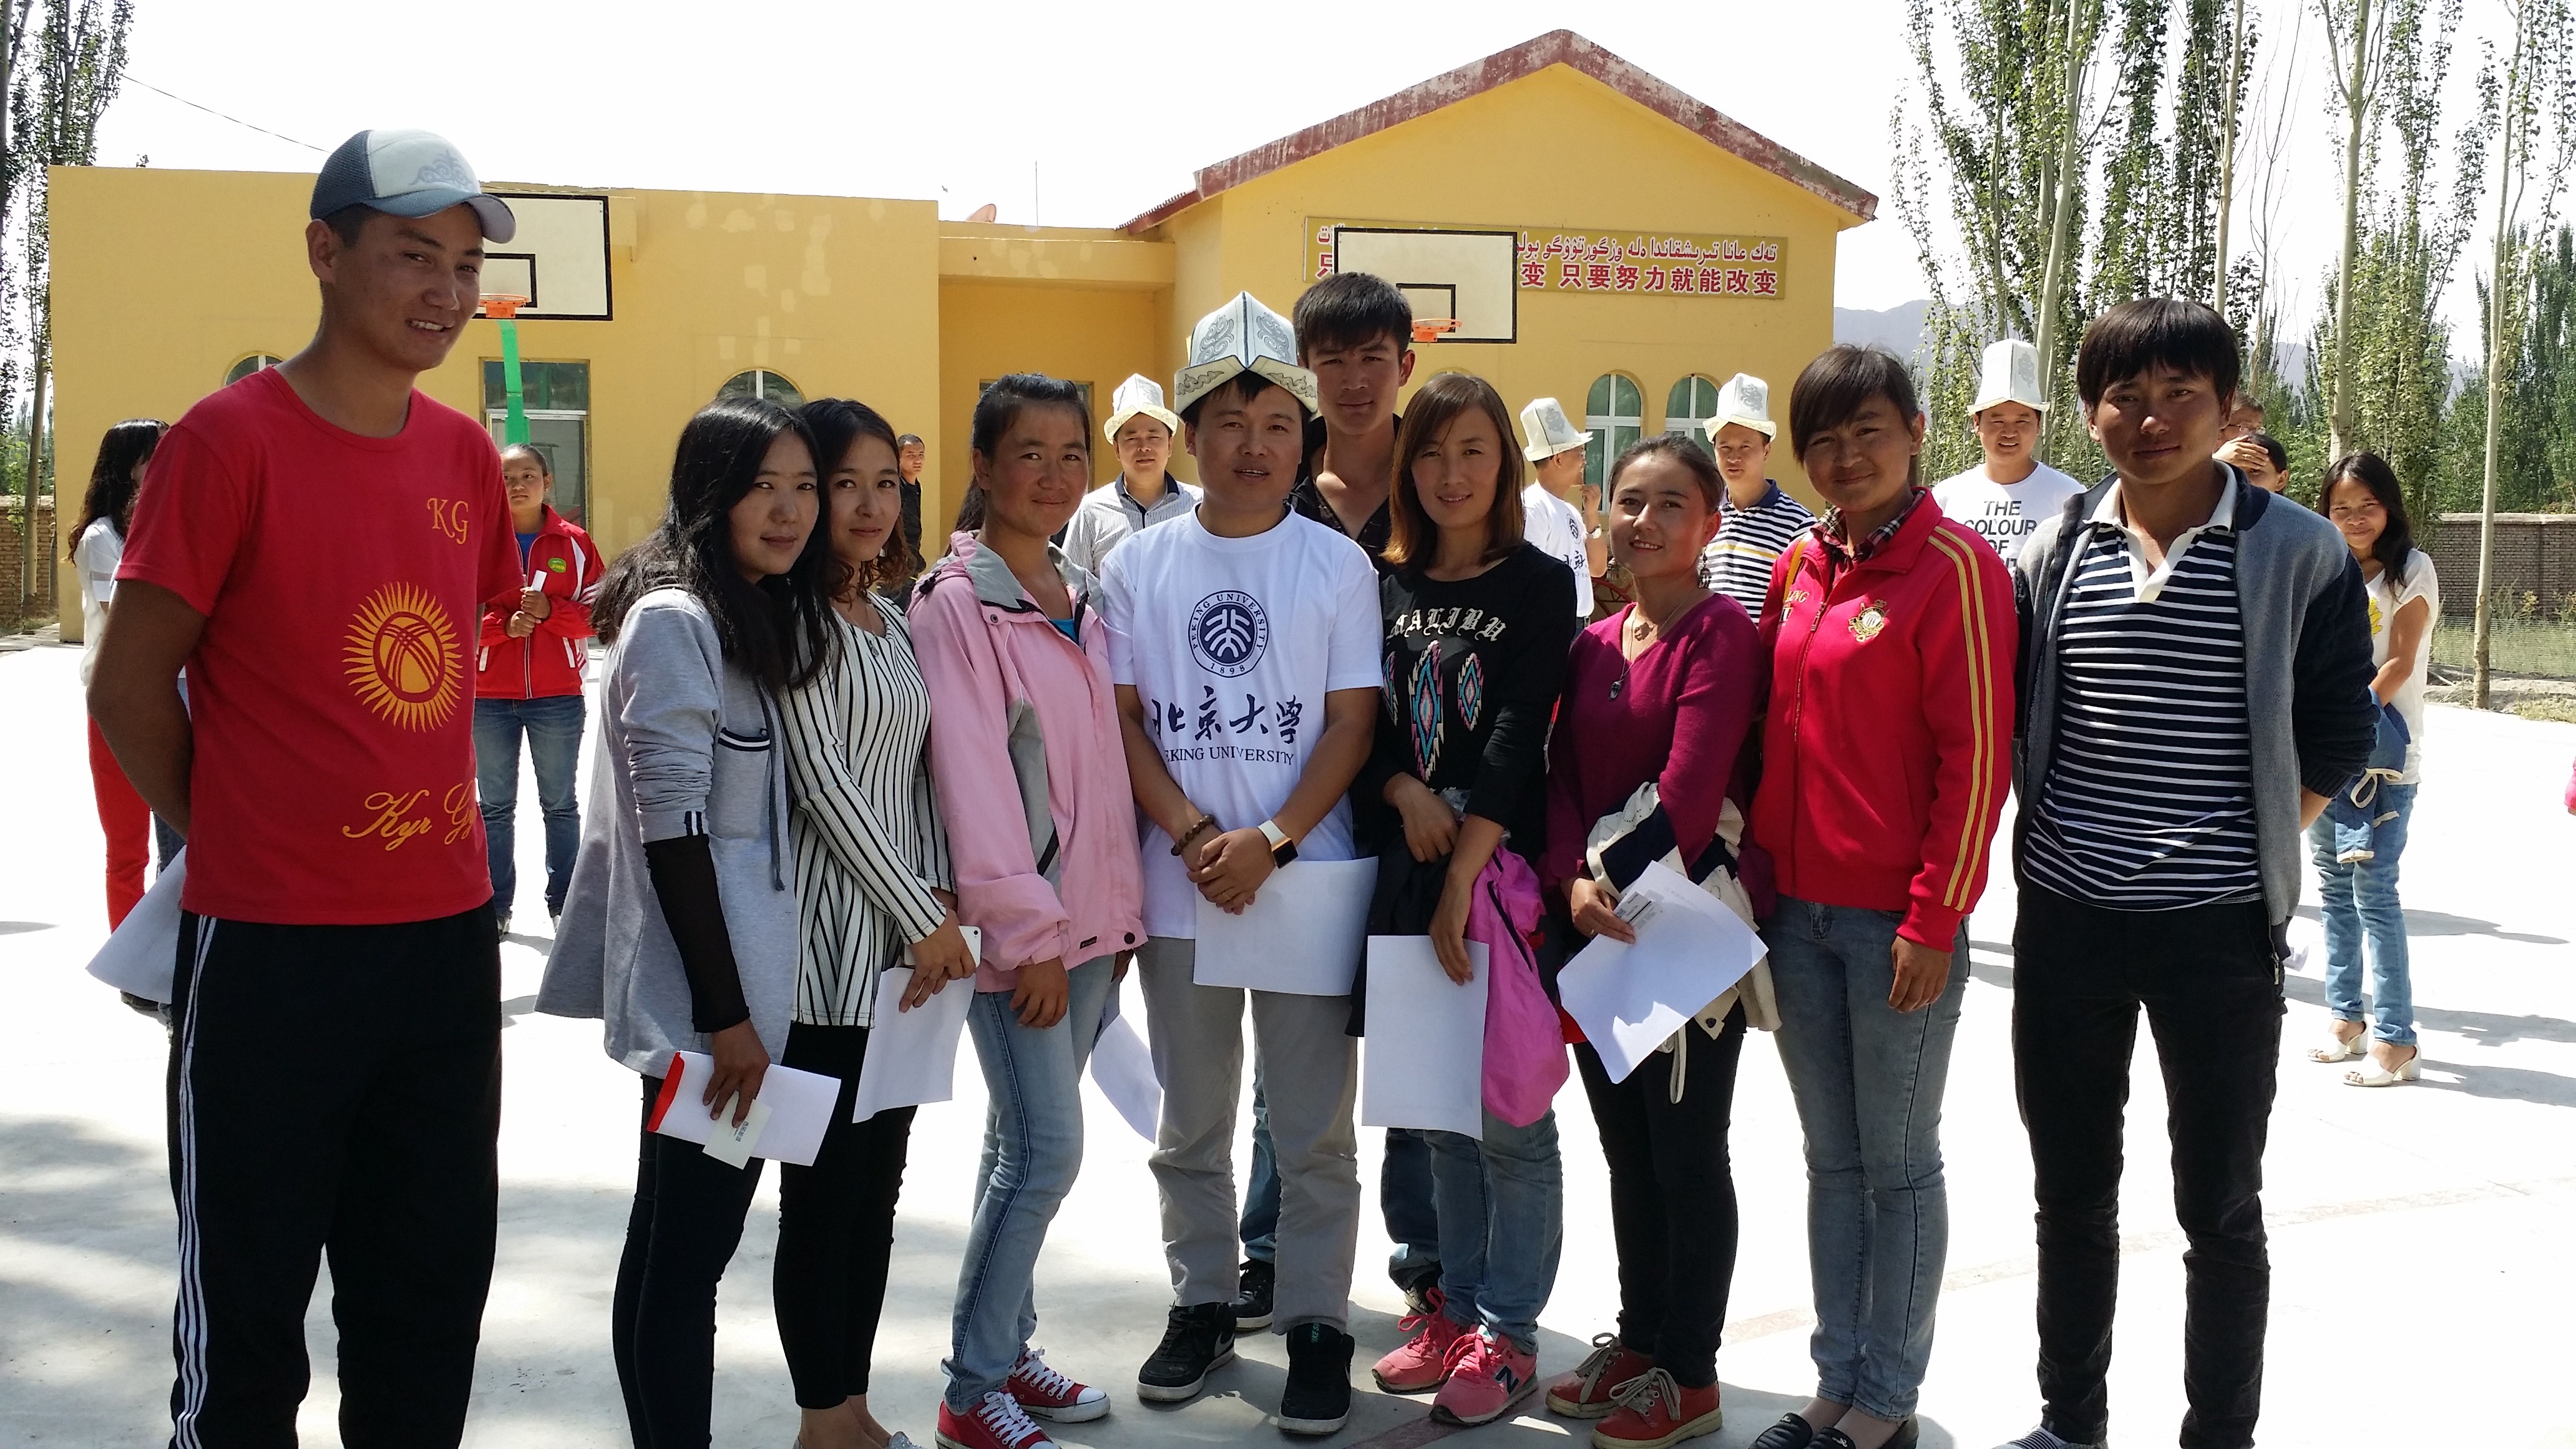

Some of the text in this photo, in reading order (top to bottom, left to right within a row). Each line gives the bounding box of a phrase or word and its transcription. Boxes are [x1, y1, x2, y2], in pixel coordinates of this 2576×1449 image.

[1559, 263, 1776, 295] 只要努力就能改变
[427, 497, 469, 545] KG
[1984, 500, 2022, 516] THE
[1191, 593, 1266, 651] PEKING UNIVERSITY
[1210, 663, 1246, 675] 1898
[1208, 746, 1294, 766] UNIVERSITY
